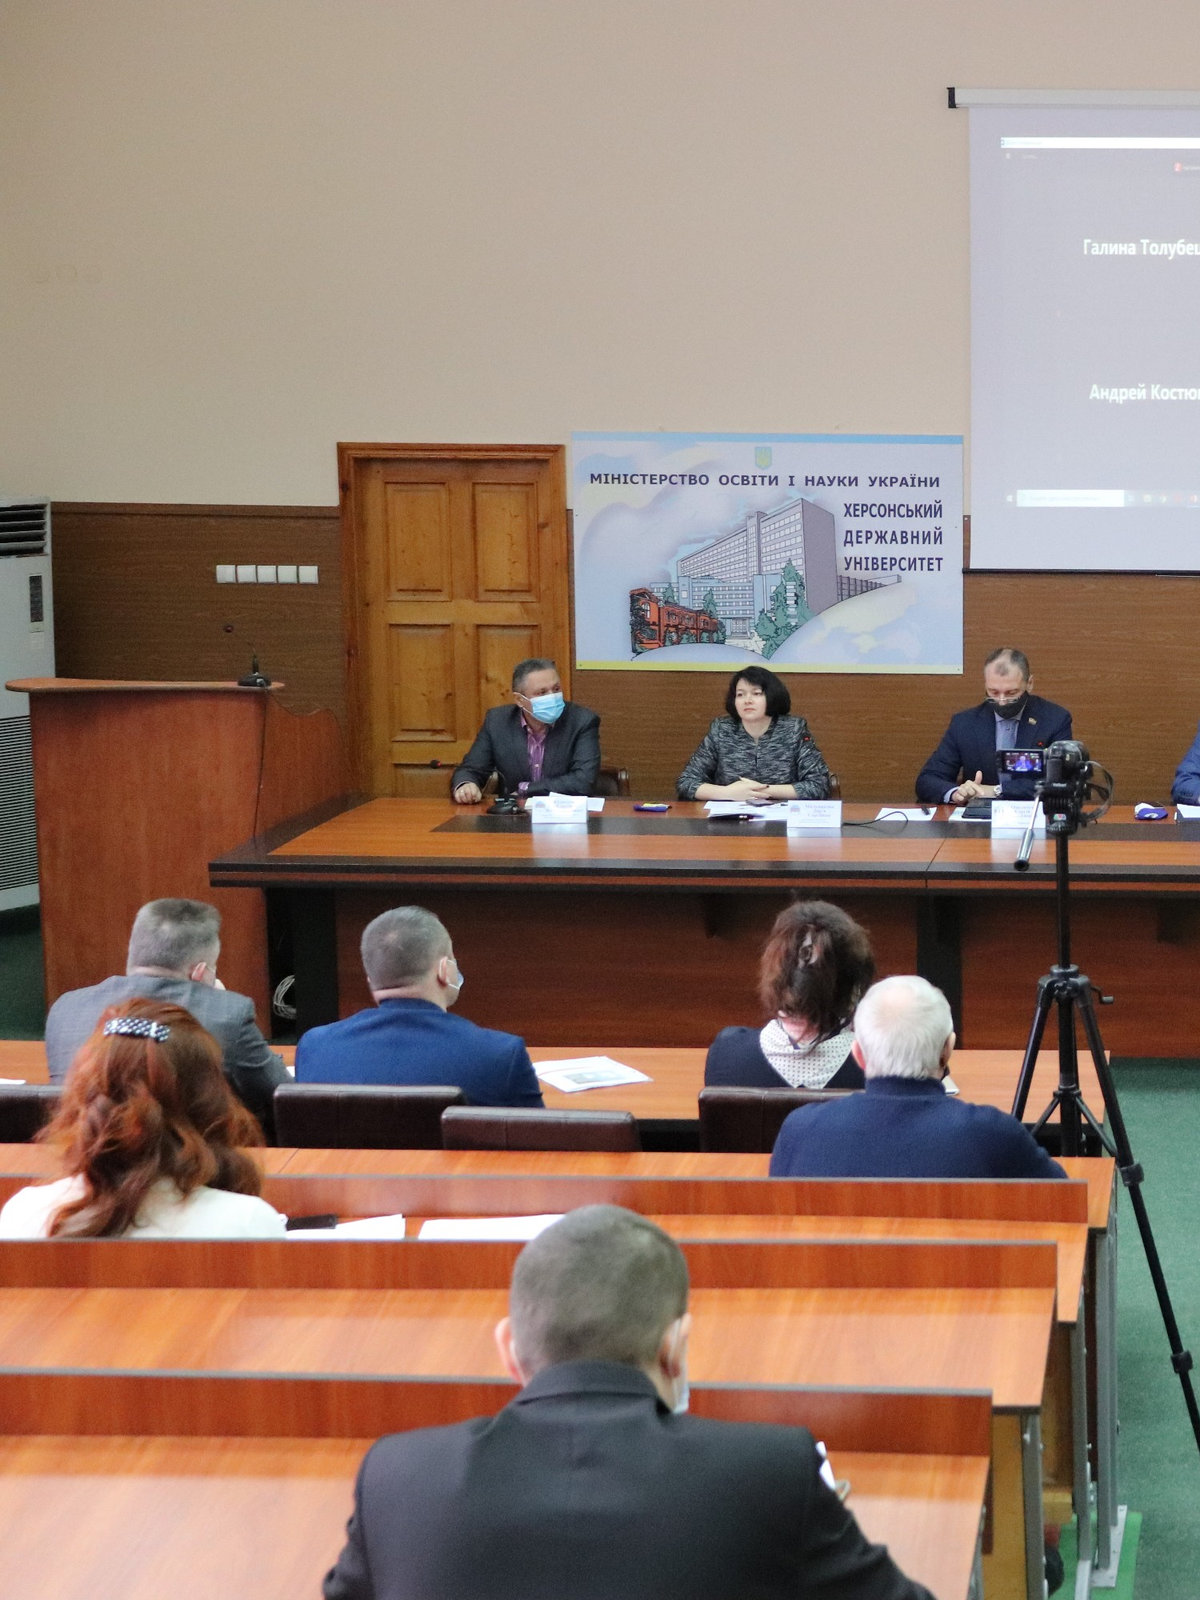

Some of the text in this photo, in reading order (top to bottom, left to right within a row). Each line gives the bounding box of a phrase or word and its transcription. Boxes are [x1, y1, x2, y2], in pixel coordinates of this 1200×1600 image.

[1083, 239, 1136, 255] Галина
[1089, 383, 1146, 404] Андрей
[590, 473, 940, 488] МІНІСТЕРСТВО ОСВІТИ І НАУКИ УКРАЇНИ
[843, 500, 943, 518] ХЕРСОНСЬКИЙ
[843, 526, 943, 547] ДЕРЖАВНИЙ
[844, 556, 943, 571] УНІВЕРСИТЕТ
